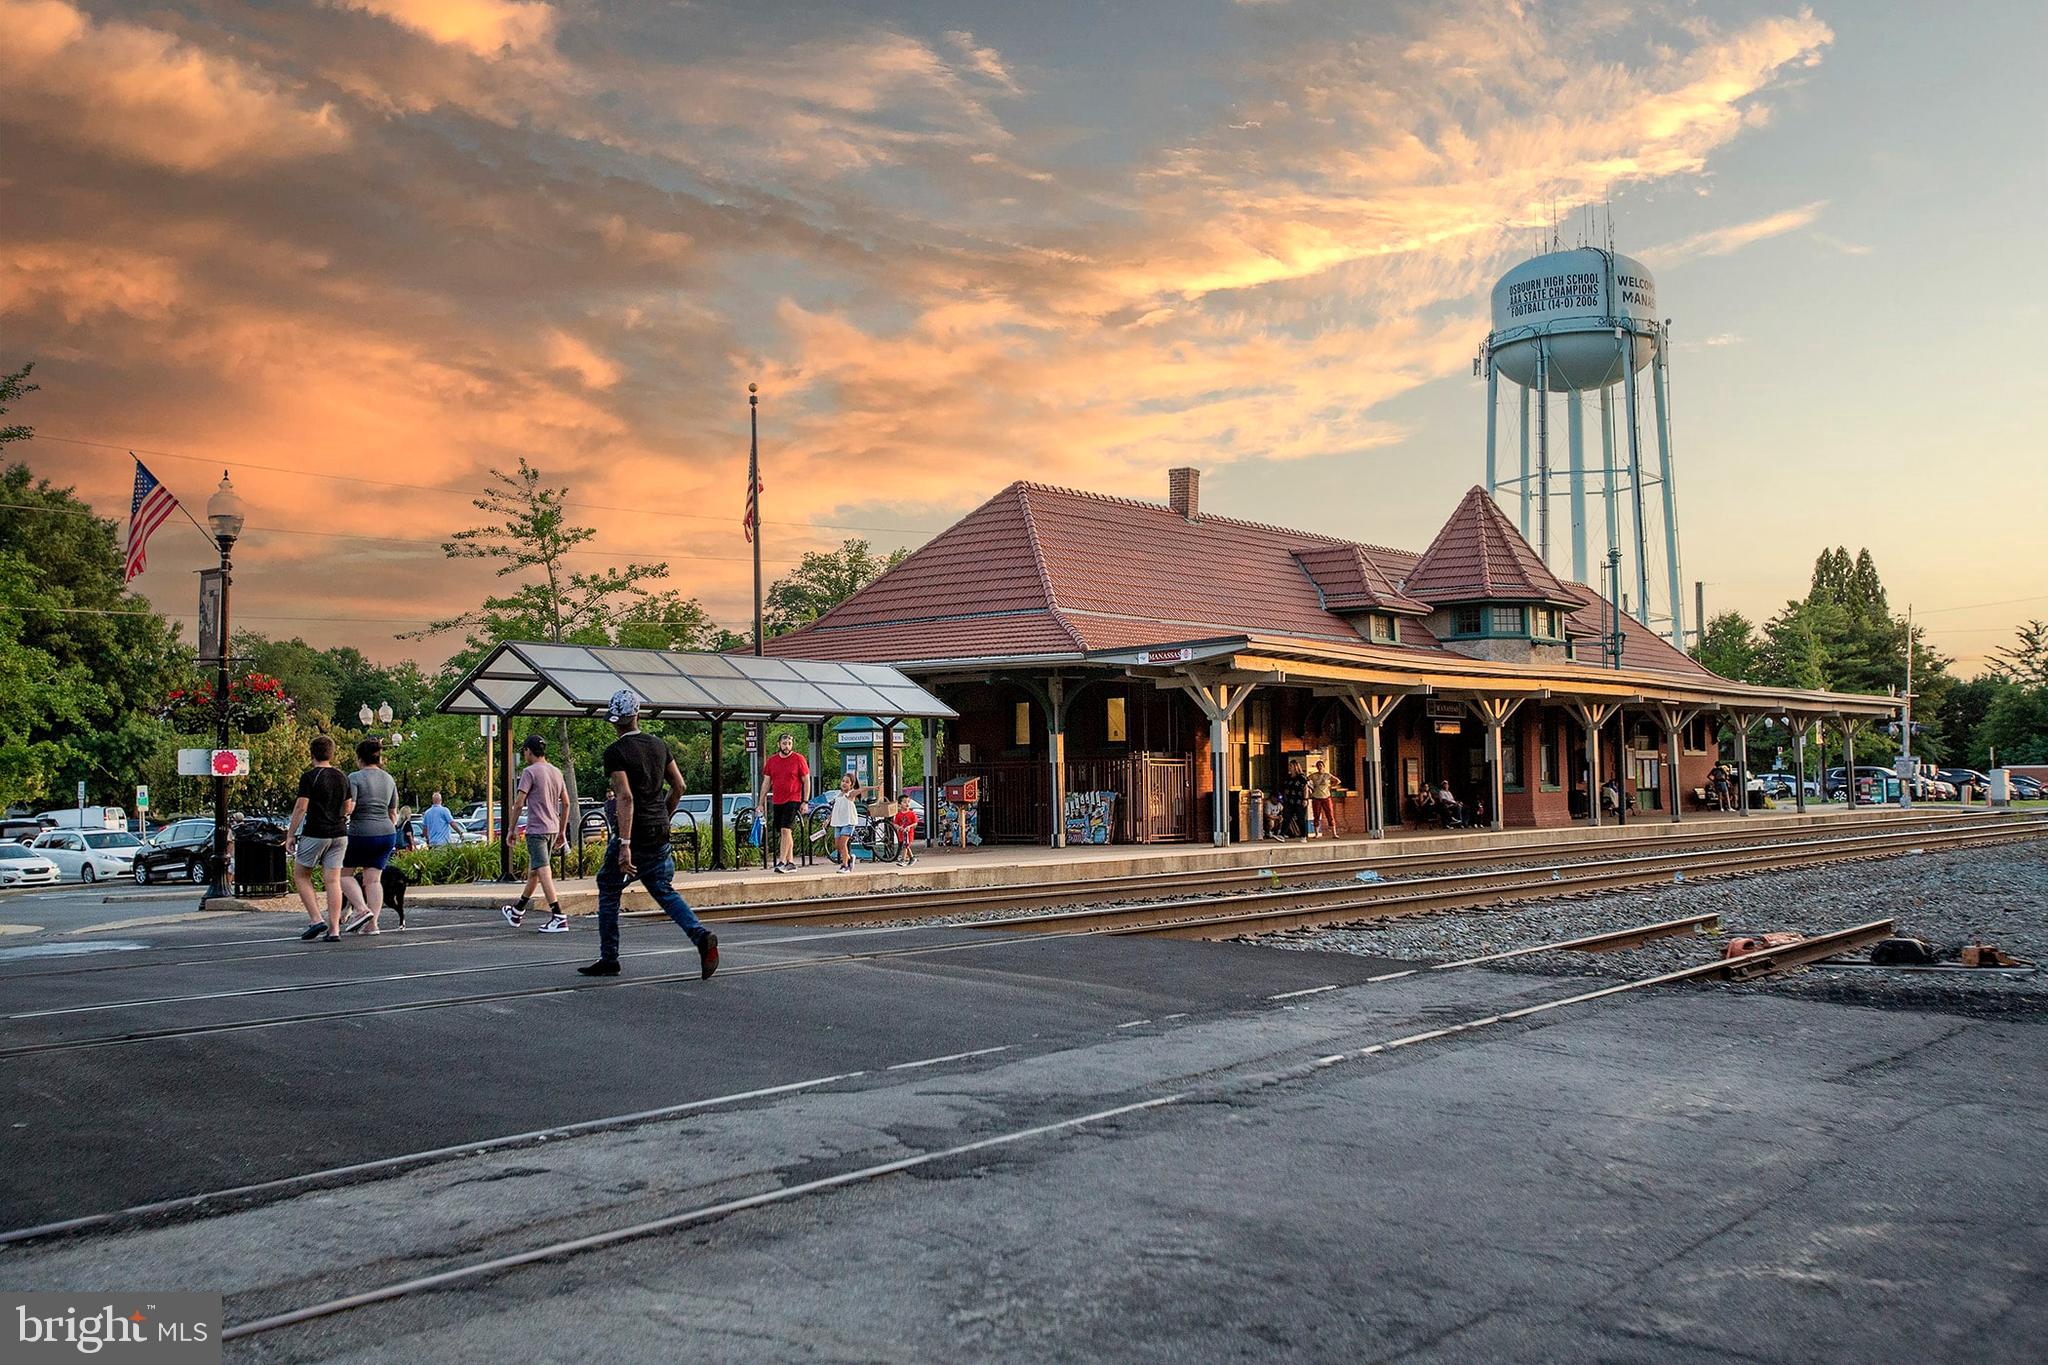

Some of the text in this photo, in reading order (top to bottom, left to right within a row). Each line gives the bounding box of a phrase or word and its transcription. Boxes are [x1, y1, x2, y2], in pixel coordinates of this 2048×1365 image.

[1509, 273, 1599, 296] OSBOURN HIGH SCHOOL
[1510, 284, 1599, 305] AAA STATE CHAMPIONS
[1511, 301, 1545, 317] FOOTBALL
[1576, 296, 1598, 307] 2006
